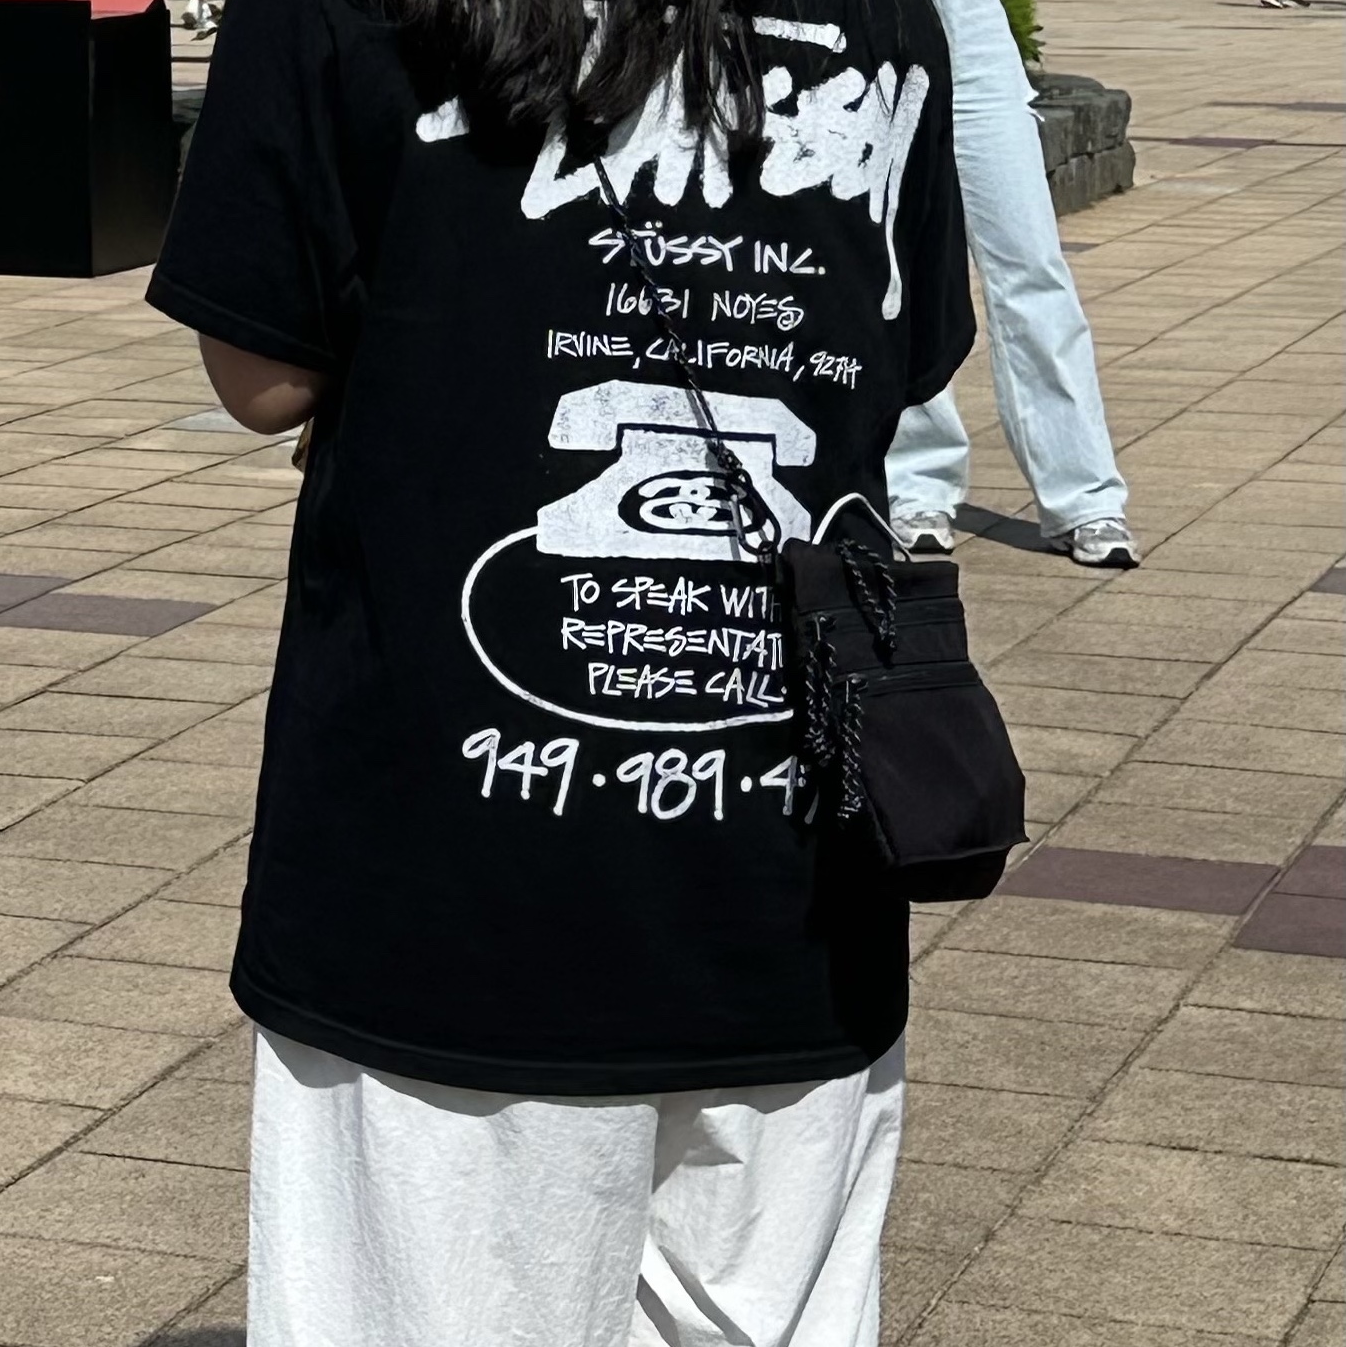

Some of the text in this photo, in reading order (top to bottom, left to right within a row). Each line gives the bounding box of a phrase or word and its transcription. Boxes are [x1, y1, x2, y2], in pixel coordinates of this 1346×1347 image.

[754, 240, 826, 275] INC.
[547, 329, 641, 369] IRVINE,
[560, 572, 601, 612] TO
[611, 576, 712, 616] SPEAK
[560, 616, 784, 671] REPRESENTATI
[587, 662, 697, 700] PLEASE
